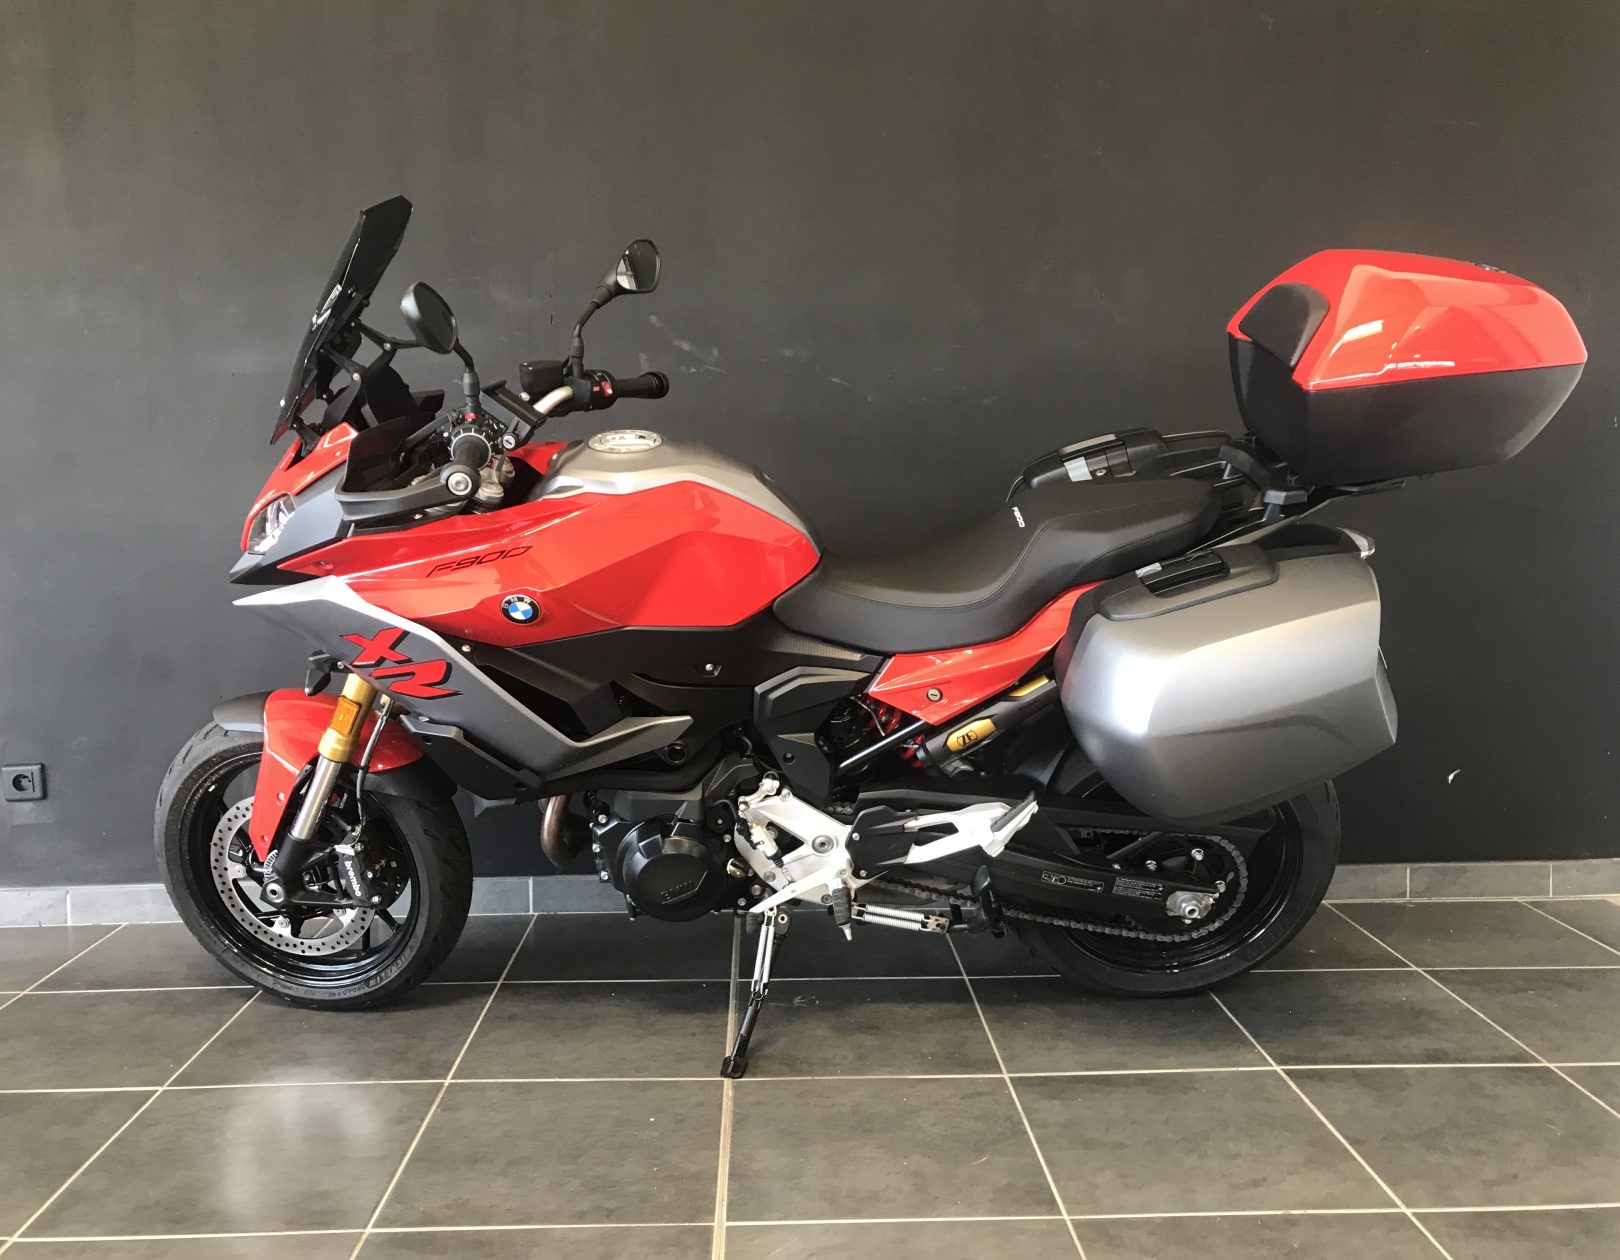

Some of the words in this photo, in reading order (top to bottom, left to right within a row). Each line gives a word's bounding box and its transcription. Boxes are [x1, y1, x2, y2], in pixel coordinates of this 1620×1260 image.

[426, 546, 533, 577] F900
[502, 596, 532, 609] BMW
[344, 861, 361, 896] brembo
